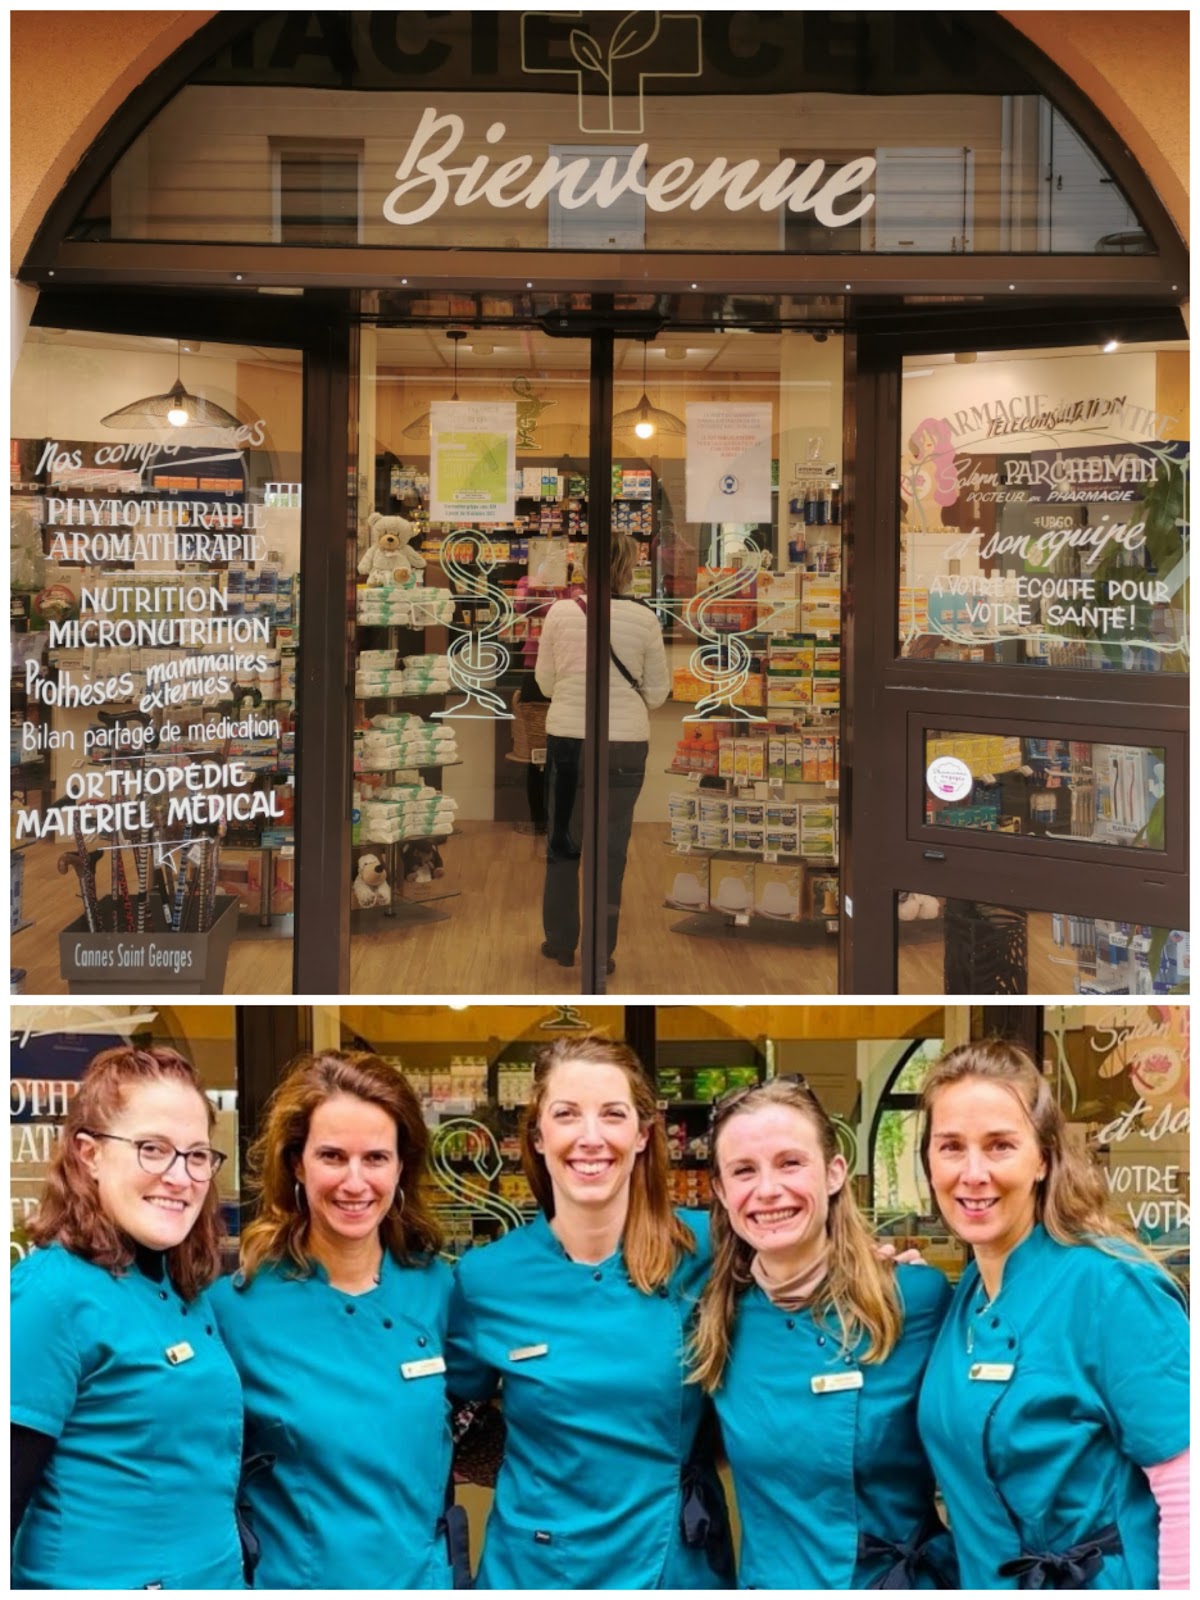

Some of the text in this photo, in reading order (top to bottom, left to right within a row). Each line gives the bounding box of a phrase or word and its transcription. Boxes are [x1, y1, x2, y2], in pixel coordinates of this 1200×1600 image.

[382, 107, 876, 228] Bienvenue
[35, 441, 82, 476] Nos
[1004, 457, 1159, 490] PARCHEMIN
[966, 491, 1025, 503] DOCTEUR
[1046, 490, 1134, 503] PHARMACIE
[47, 497, 267, 529] PHYTOTHERAPIE
[1041, 516, 1074, 529] URGO
[44, 531, 268, 563] AROMATHERAPIE
[976, 531, 1031, 560] son
[1036, 514, 1147, 568] équipe
[81, 587, 229, 613] NUTRITION
[948, 575, 1005, 598] VOTRE
[1016, 574, 1096, 600] ÉCOUTE
[1109, 580, 1171, 604] POUR
[965, 602, 1031, 627] VOTRE
[49, 617, 270, 648] MICRONUTRITION
[25, 646, 268, 708] Prothèses mammaires
[139, 674, 231, 713] externes
[22, 713, 280, 755] Bilan partagé de médication
[65, 761, 249, 800] ORTHOPÉDIE
[15, 789, 285, 840] MATÉRIEL MÉDICAL
[75, 943, 192, 974] Cannes Saint Georges
[1096, 1097, 1190, 1144] et so
[1104, 1164, 1181, 1194] VOTRE
